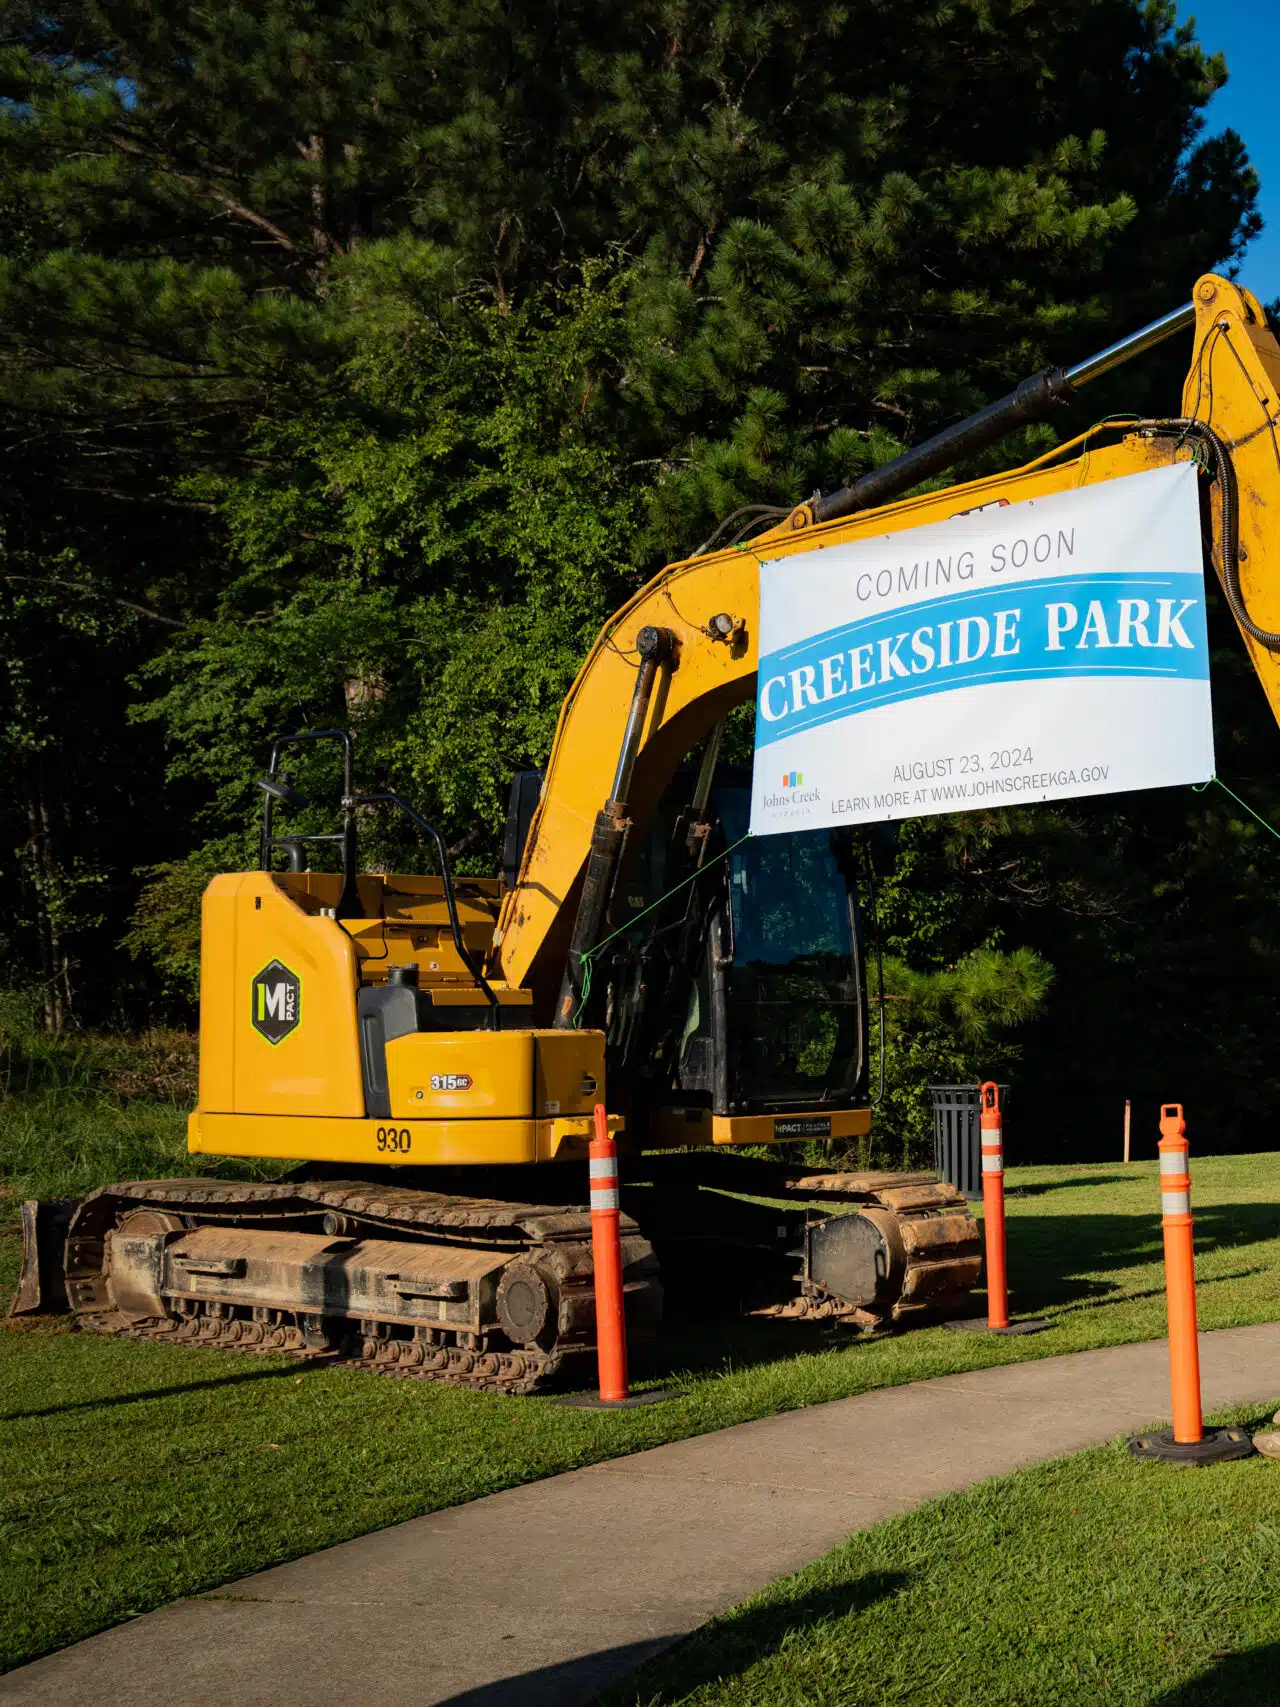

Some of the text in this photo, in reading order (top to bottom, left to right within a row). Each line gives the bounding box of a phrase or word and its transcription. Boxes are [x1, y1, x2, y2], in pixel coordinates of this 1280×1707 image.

[856, 527, 1076, 602] COMING SOON
[760, 598, 1199, 723] CREEKSIDE PARK
[893, 746, 1034, 783] AUGUST 23, 2024
[763, 787, 821, 809] Johns Creek
[831, 765, 1110, 815] LEARN MORE AT WWW.JOHNSCREEKGA.GOV
[627, 895, 644, 907] CAT
[286, 983, 295, 1021] PACT
[376, 1126, 412, 1154] 930
